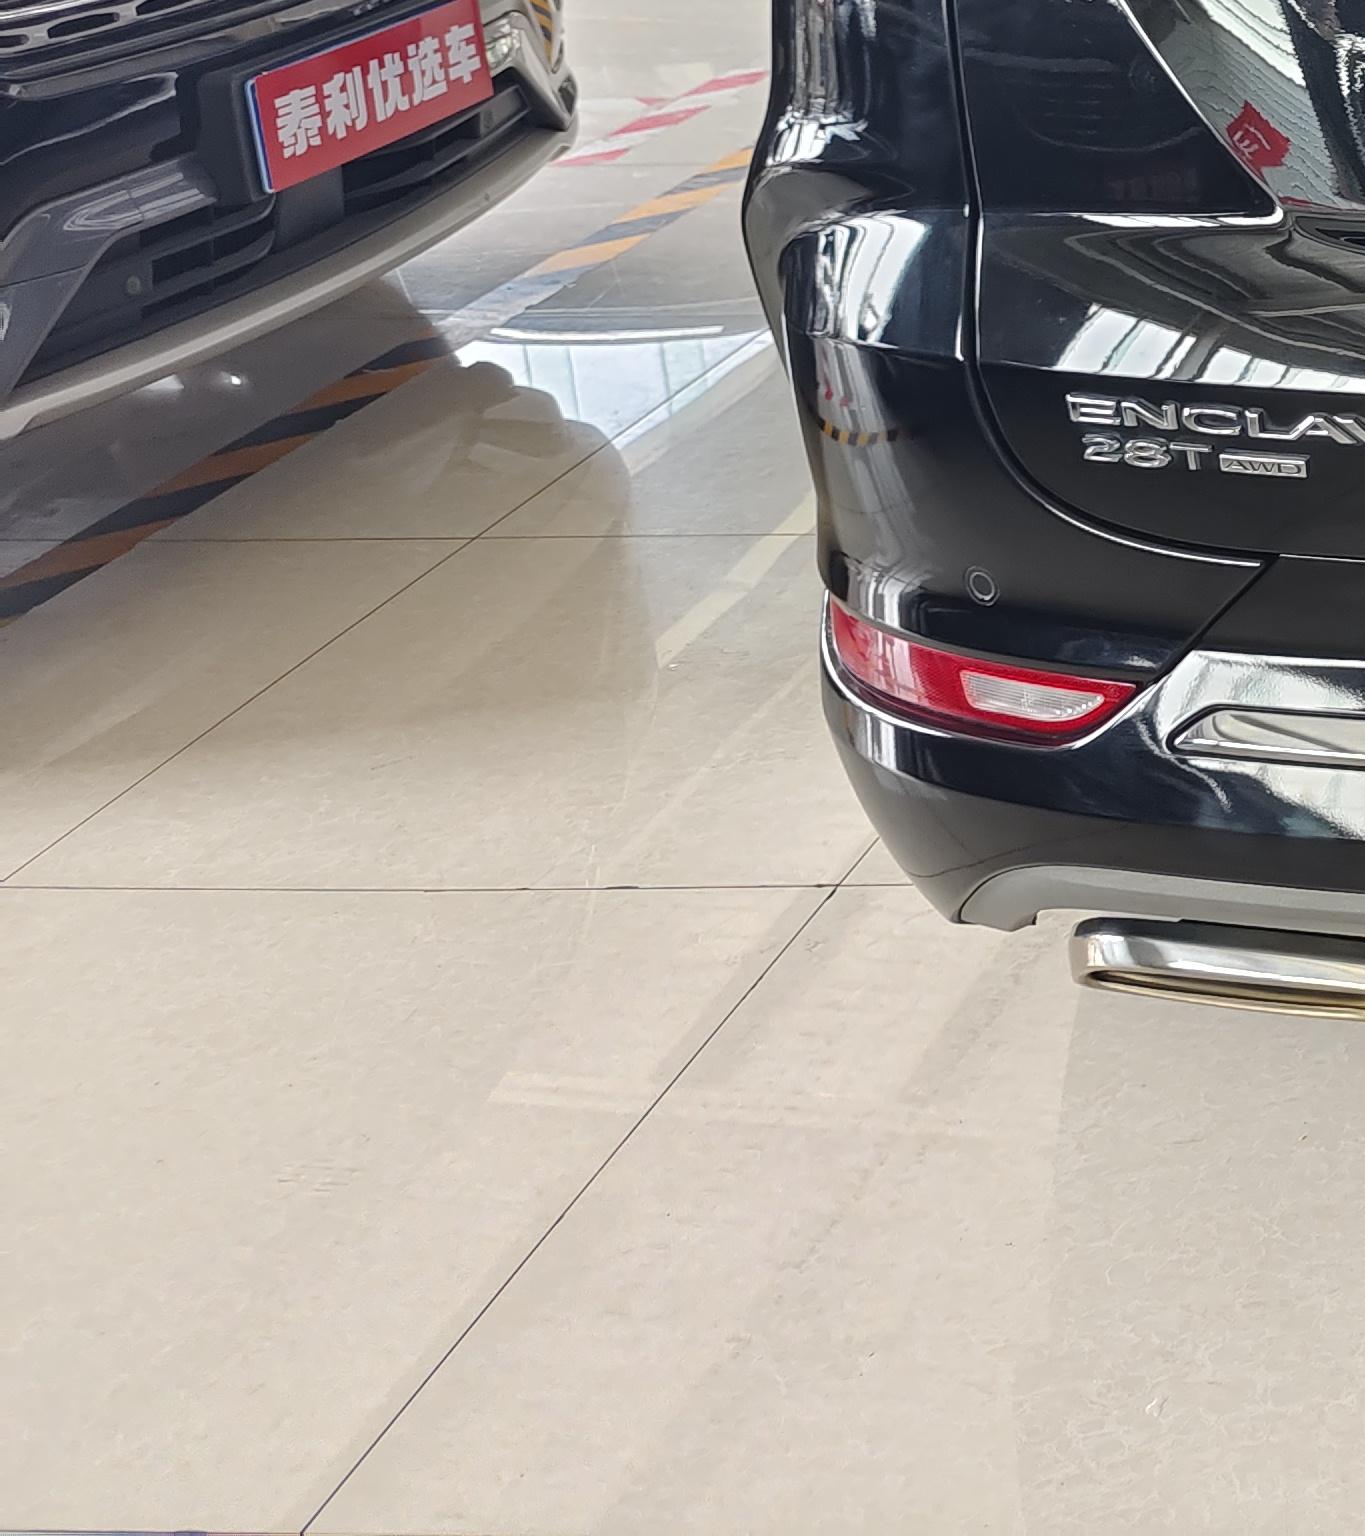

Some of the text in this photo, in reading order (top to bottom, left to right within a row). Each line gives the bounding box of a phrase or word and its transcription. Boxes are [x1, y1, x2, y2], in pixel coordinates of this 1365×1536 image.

[274, 23, 481, 160] 泰利优选车
[1082, 433, 1306, 476] 28T AWD
